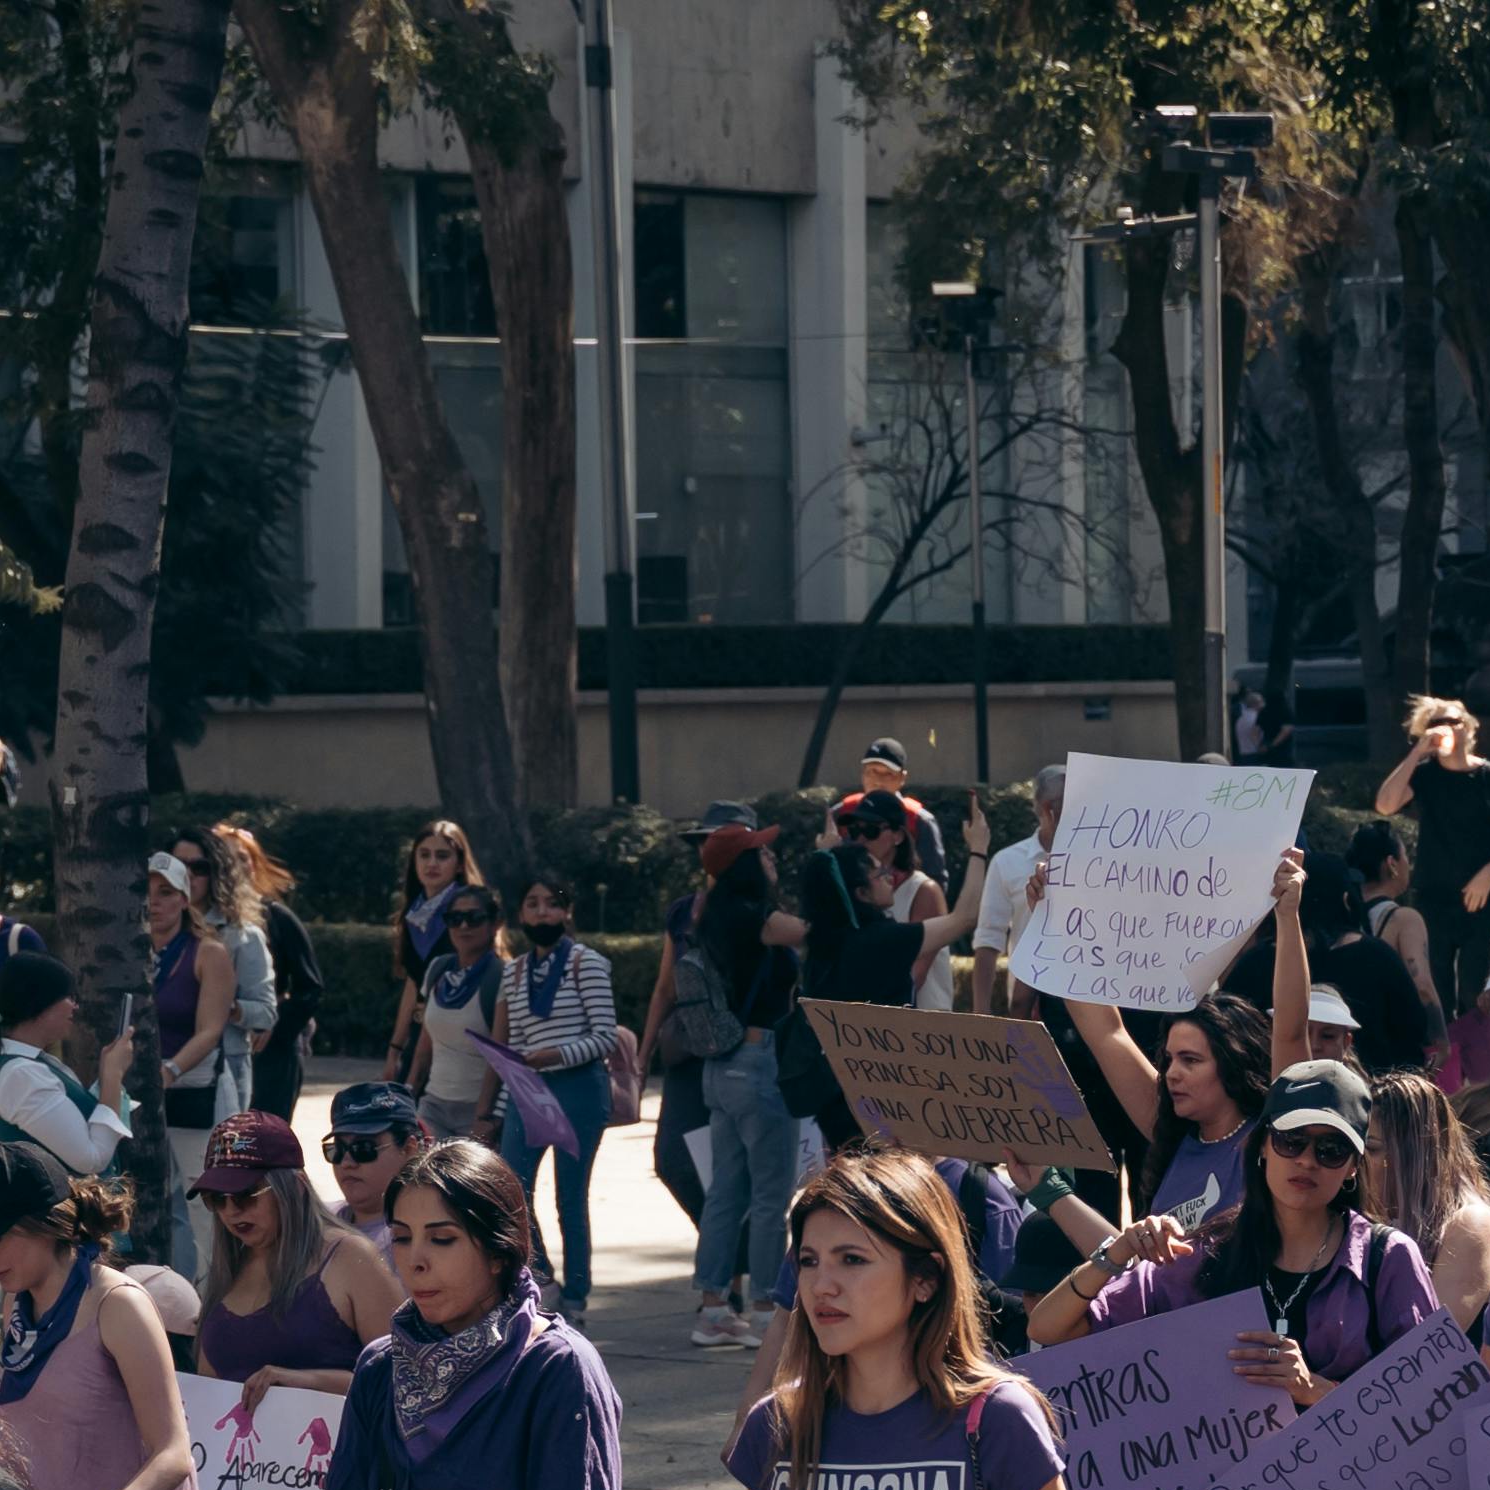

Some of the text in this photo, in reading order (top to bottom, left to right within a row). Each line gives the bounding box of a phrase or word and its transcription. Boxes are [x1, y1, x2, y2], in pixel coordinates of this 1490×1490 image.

[1206, 773, 1297, 811] #8M
[815, 1007, 1019, 1065] YO NO SOY UNA
[969, 1072, 1018, 1102] SOY
[1357, 1317, 1466, 1417] espantas
[1339, 1434, 1397, 1489] que
